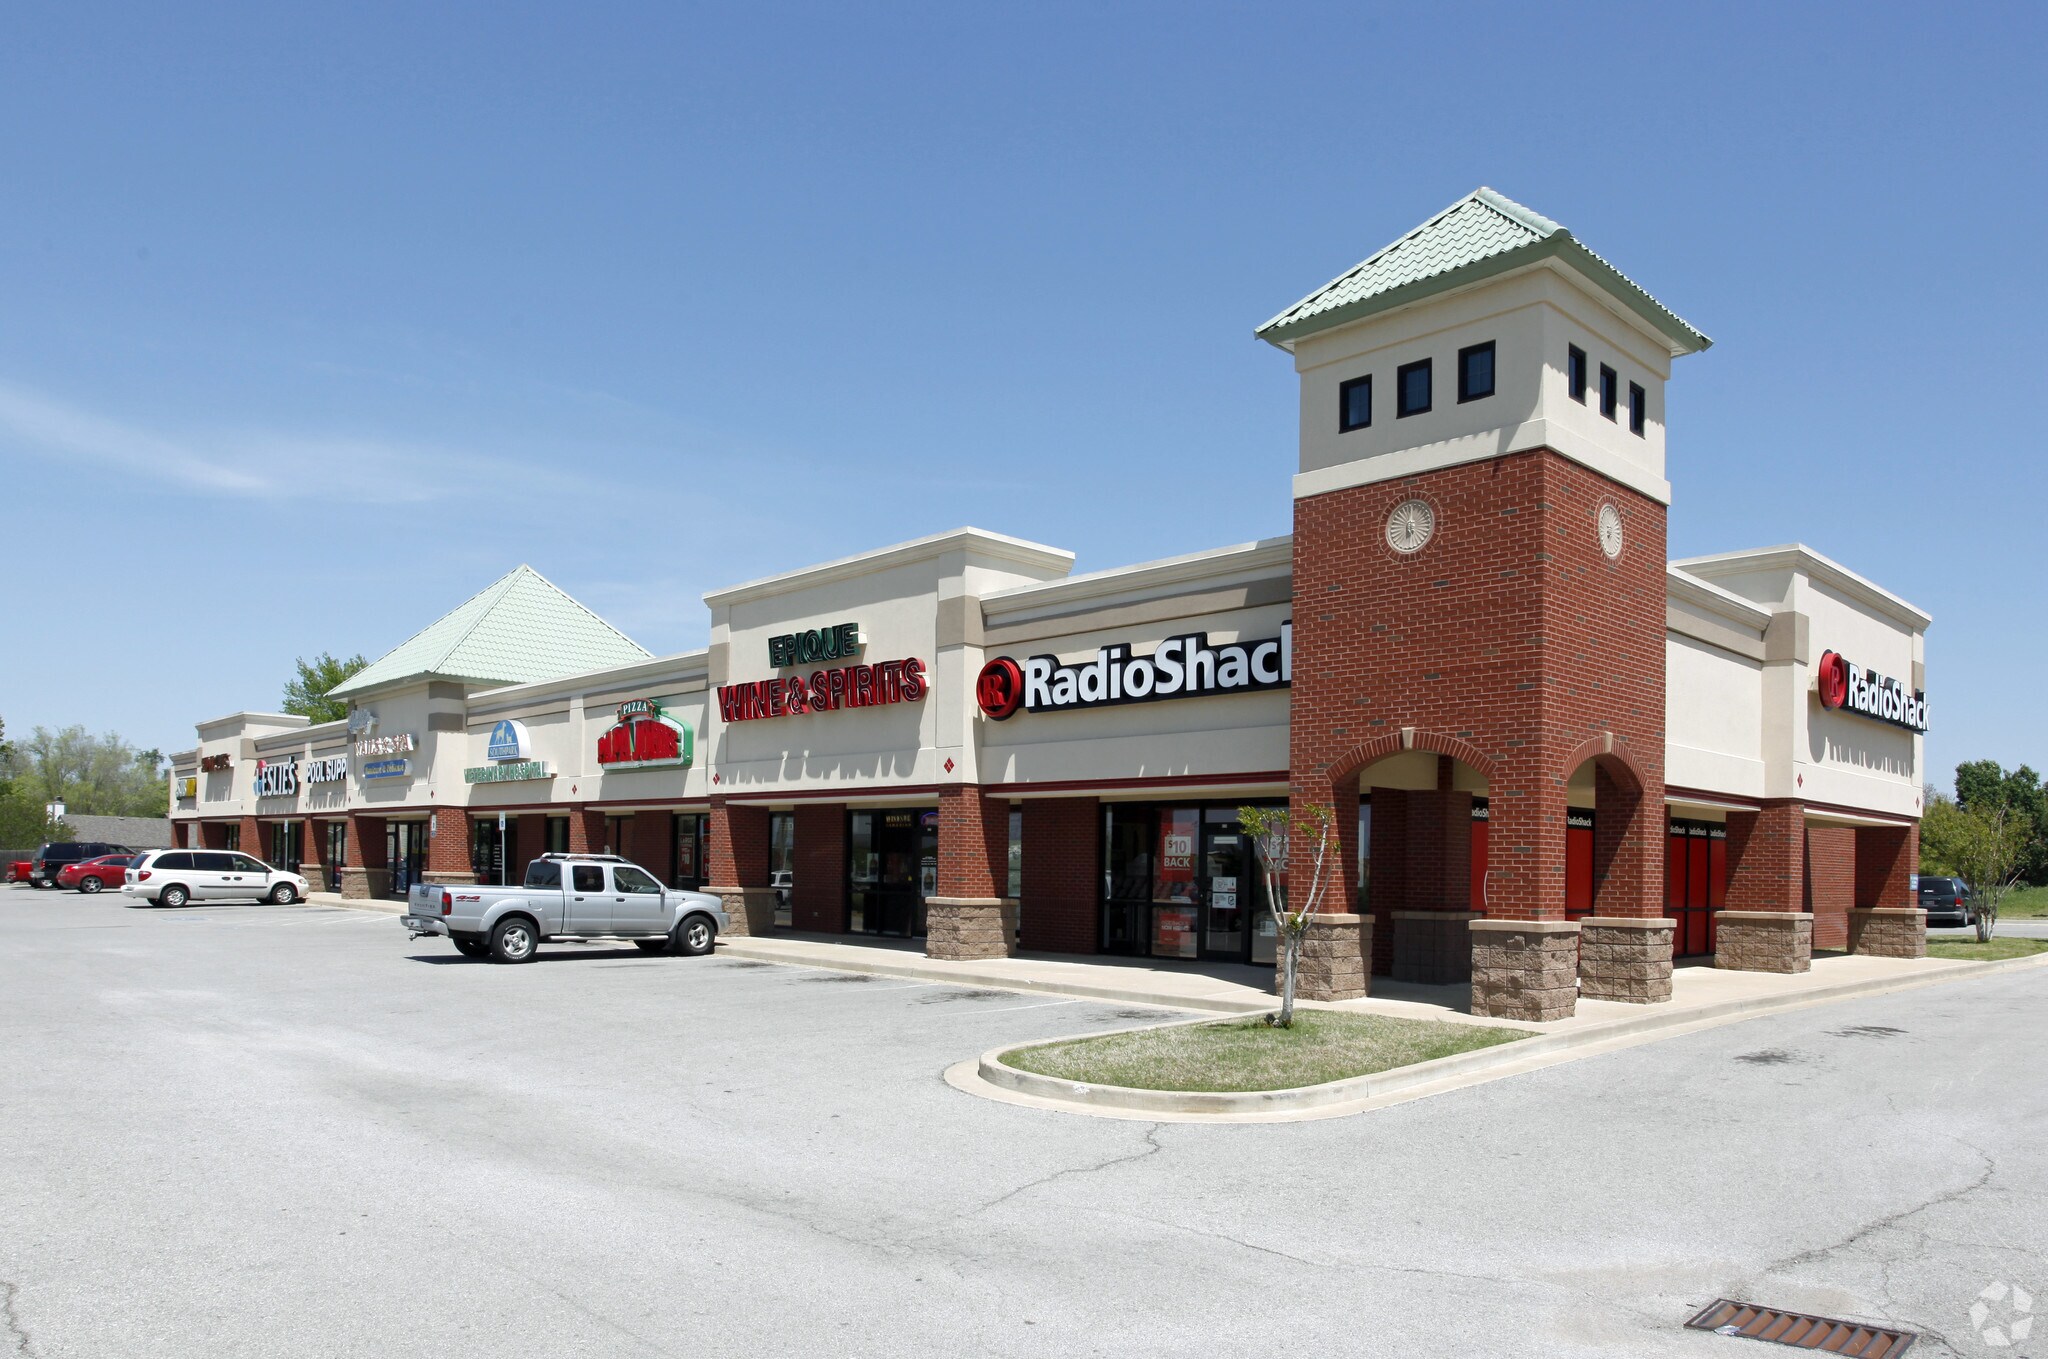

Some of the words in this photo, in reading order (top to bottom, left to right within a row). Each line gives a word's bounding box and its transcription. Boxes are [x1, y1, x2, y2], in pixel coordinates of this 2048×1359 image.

[768, 622, 859, 668] EPIQUE
[717, 678, 786, 722] WINE
[787, 676, 808, 715] &
[809, 657, 928, 713] SPIRITS
[1848, 663, 1931, 731] RadioShack
[622, 701, 648, 714] PIZZA
[254, 757, 296, 796] LESLIE'S
[307, 762, 325, 783] POOL
[1168, 840, 1187, 853] $10
[1164, 857, 1190, 868] BACK
